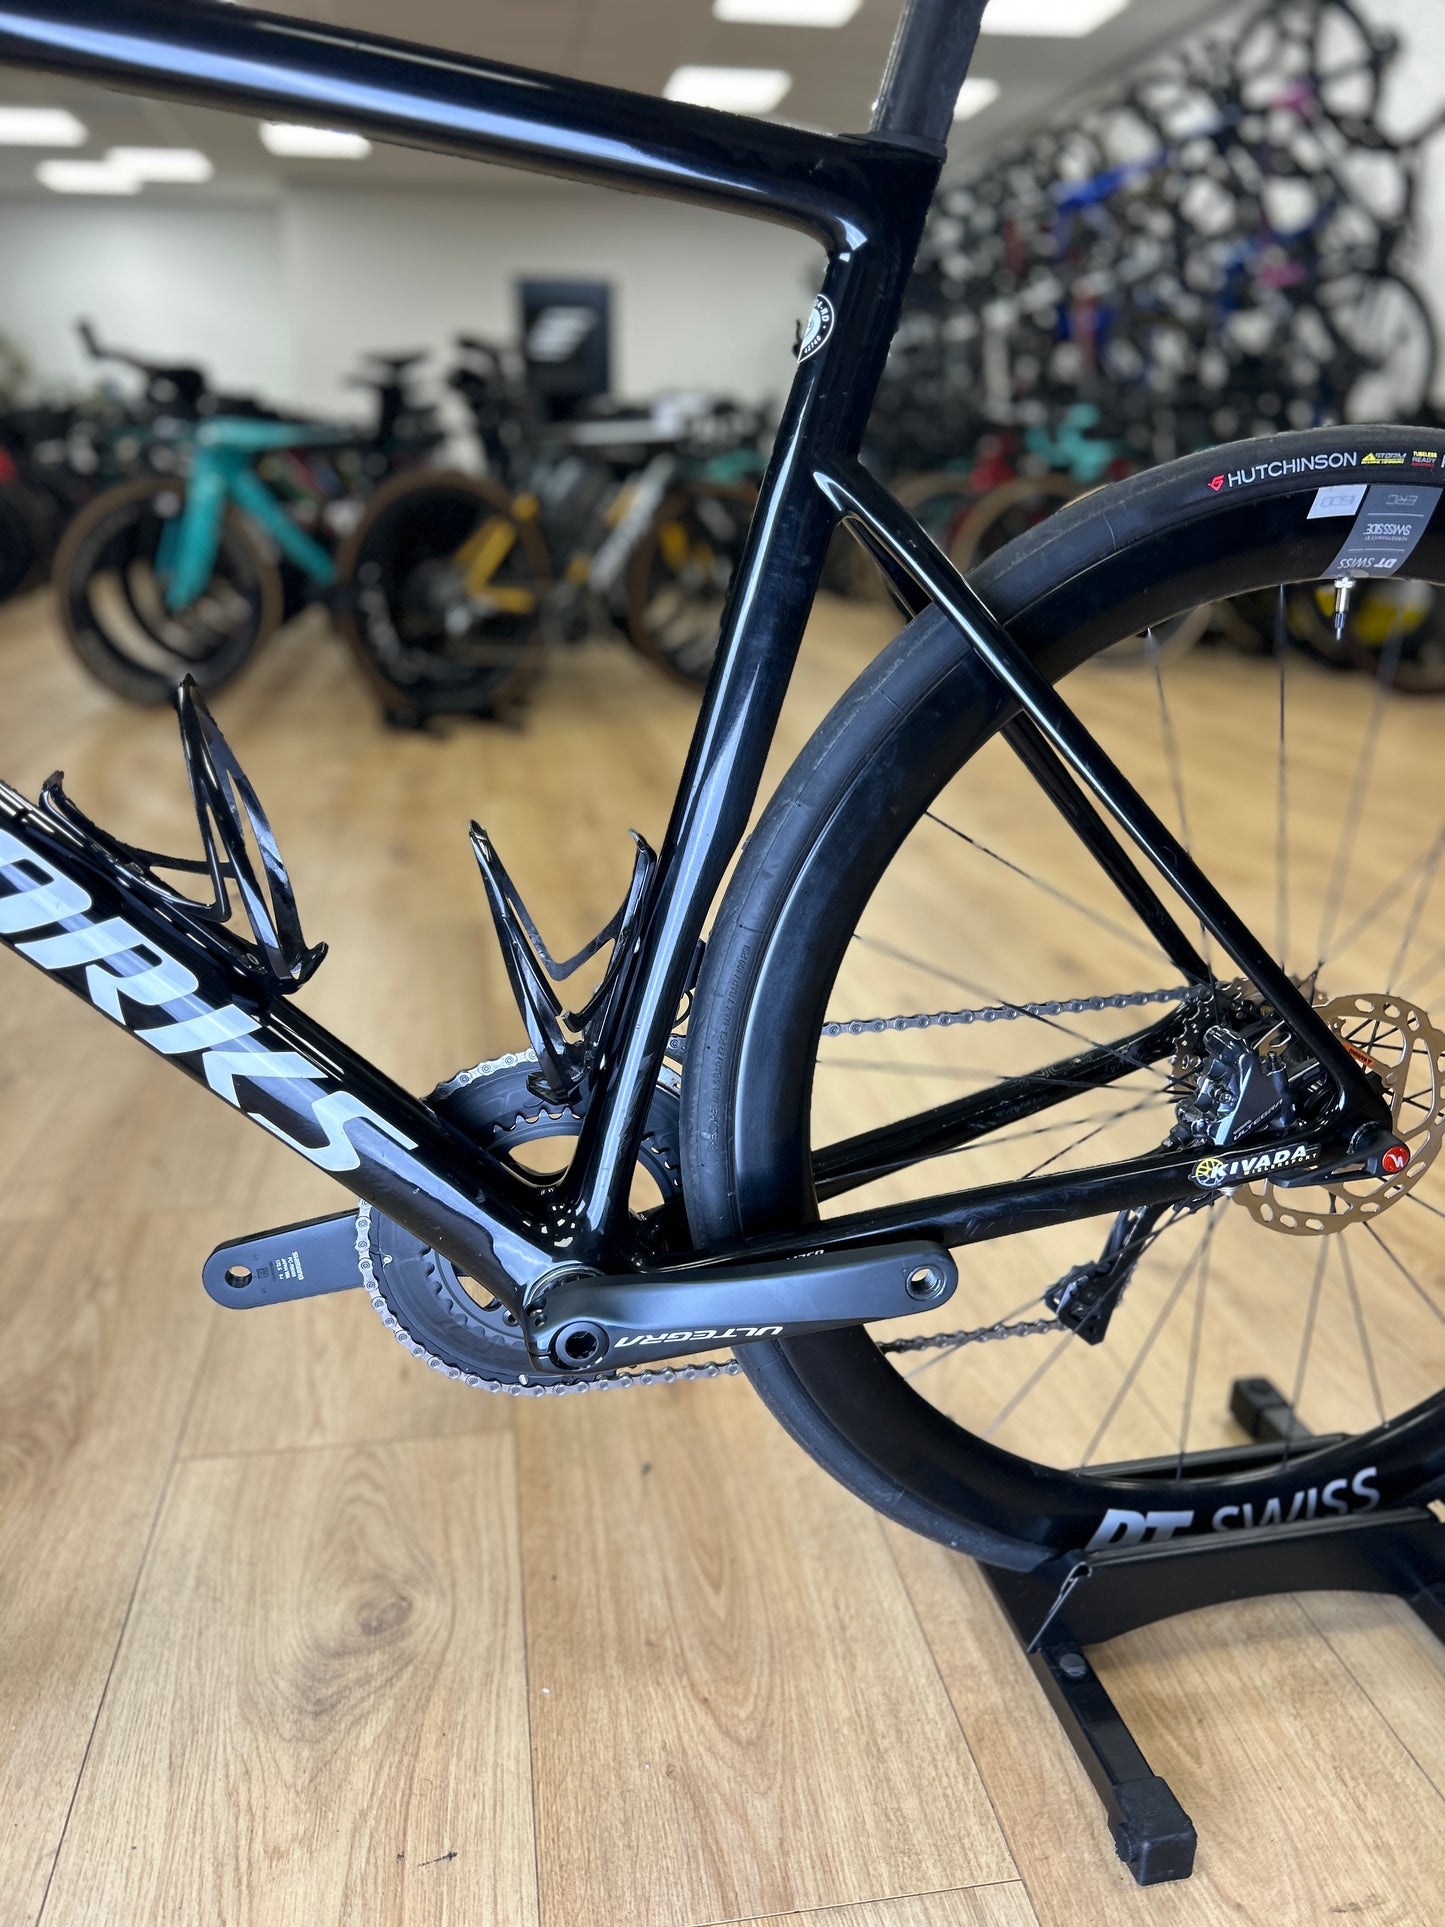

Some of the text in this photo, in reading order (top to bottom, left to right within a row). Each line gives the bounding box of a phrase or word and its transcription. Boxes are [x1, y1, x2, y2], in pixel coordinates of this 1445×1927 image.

[1227, 451, 1357, 488] HUTCHINSON
[1385, 494, 1419, 506] ERC
[1337, 557, 1398, 569] DT SWISS
[1233, 1098, 1283, 1141] ULTEGRA
[1210, 1145, 1308, 1179] KIVADA
[1243, 1153, 1318, 1176] WIELERSPORT
[291, 1250, 305, 1281] SHIMANO
[614, 1325, 784, 1349] ULTEGRA
[1085, 1466, 1381, 1550] DT SWISS
